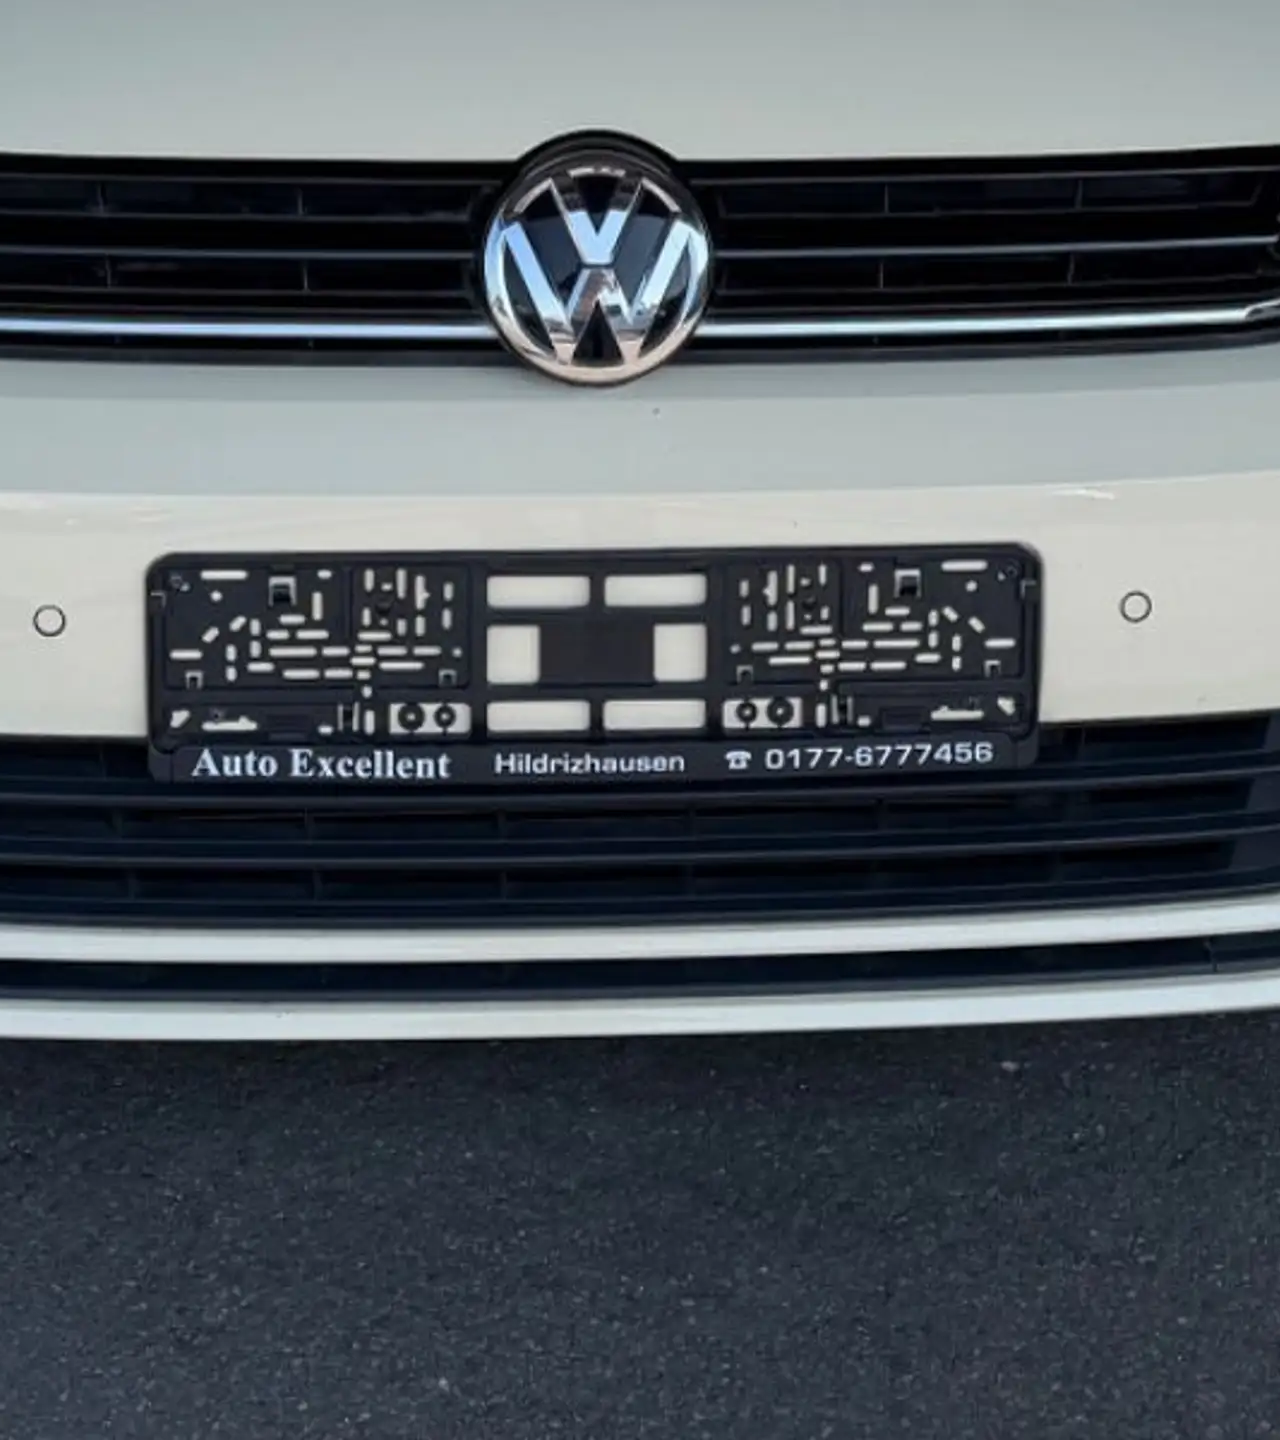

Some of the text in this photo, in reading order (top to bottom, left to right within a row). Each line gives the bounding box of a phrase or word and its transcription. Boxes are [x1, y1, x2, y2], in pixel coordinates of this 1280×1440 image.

[191, 742, 994, 779] Auto Excellent Hildrizhausen 0177-6777456
